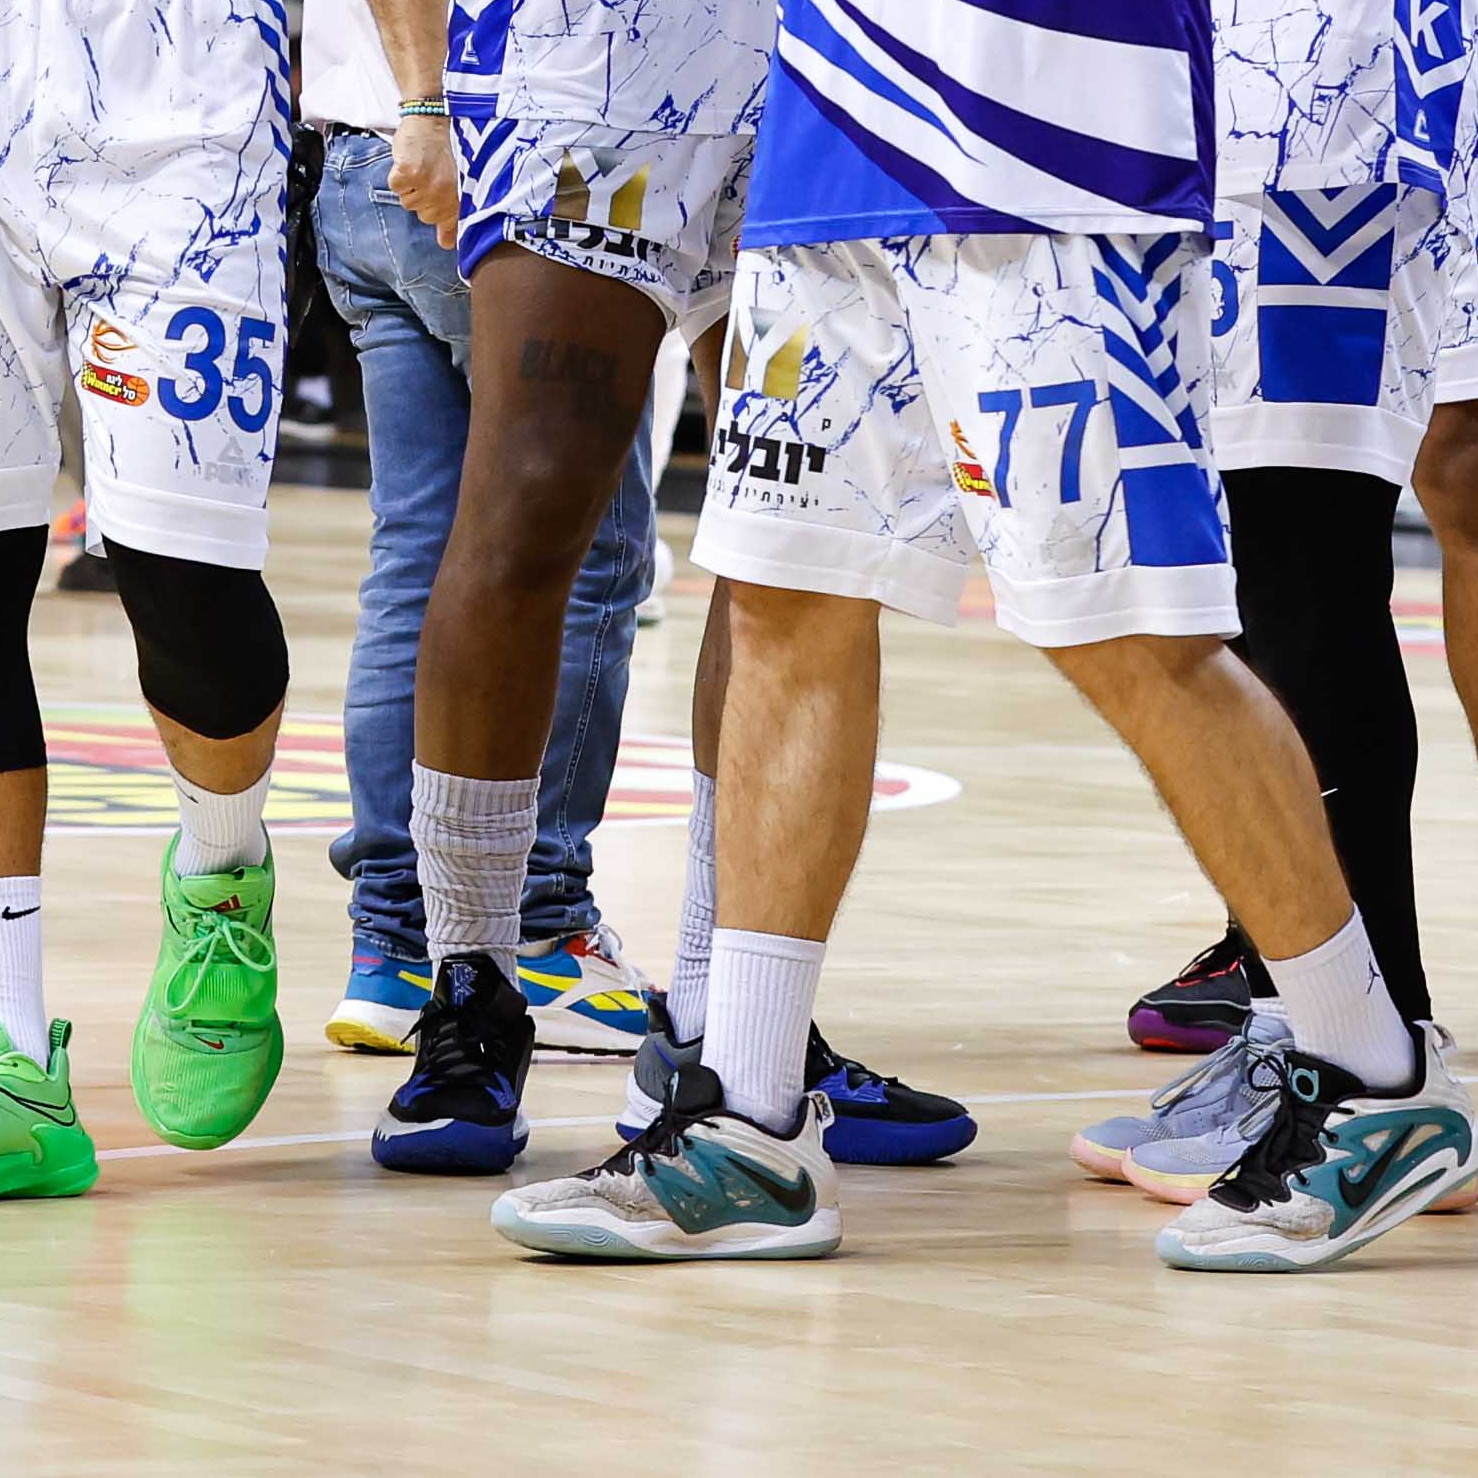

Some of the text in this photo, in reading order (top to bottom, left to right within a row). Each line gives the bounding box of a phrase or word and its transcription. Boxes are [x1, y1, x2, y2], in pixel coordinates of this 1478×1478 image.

[157, 306, 276, 434] 35
[711, 420, 827, 485] יובלי
[978, 379, 1096, 508] 77
